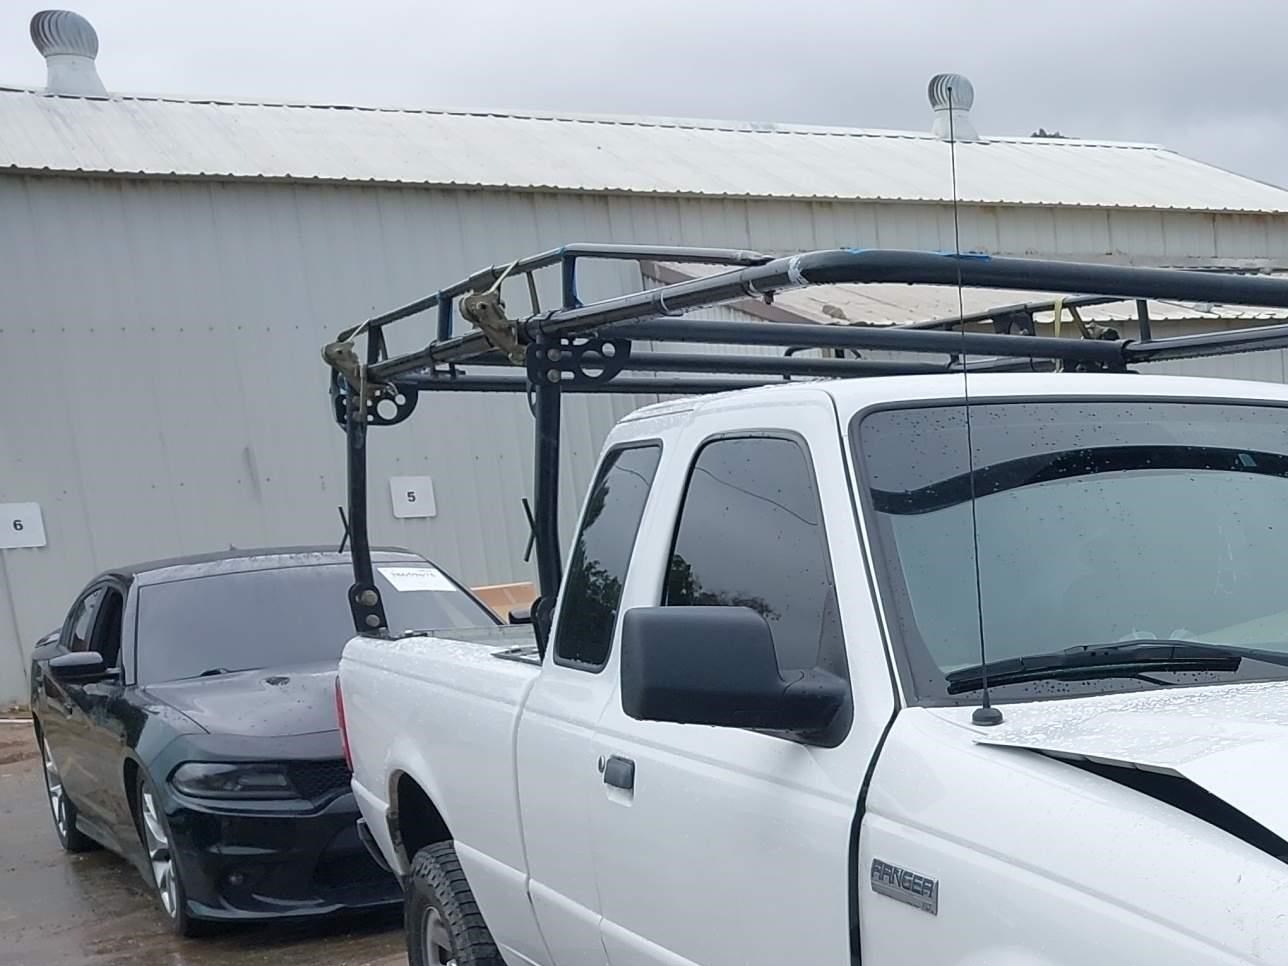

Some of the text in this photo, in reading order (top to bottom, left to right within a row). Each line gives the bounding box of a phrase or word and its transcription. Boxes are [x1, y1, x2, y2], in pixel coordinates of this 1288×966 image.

[407, 491, 416, 502] 5
[13, 519, 24, 531] 6
[872, 864, 935, 898] RANGER
